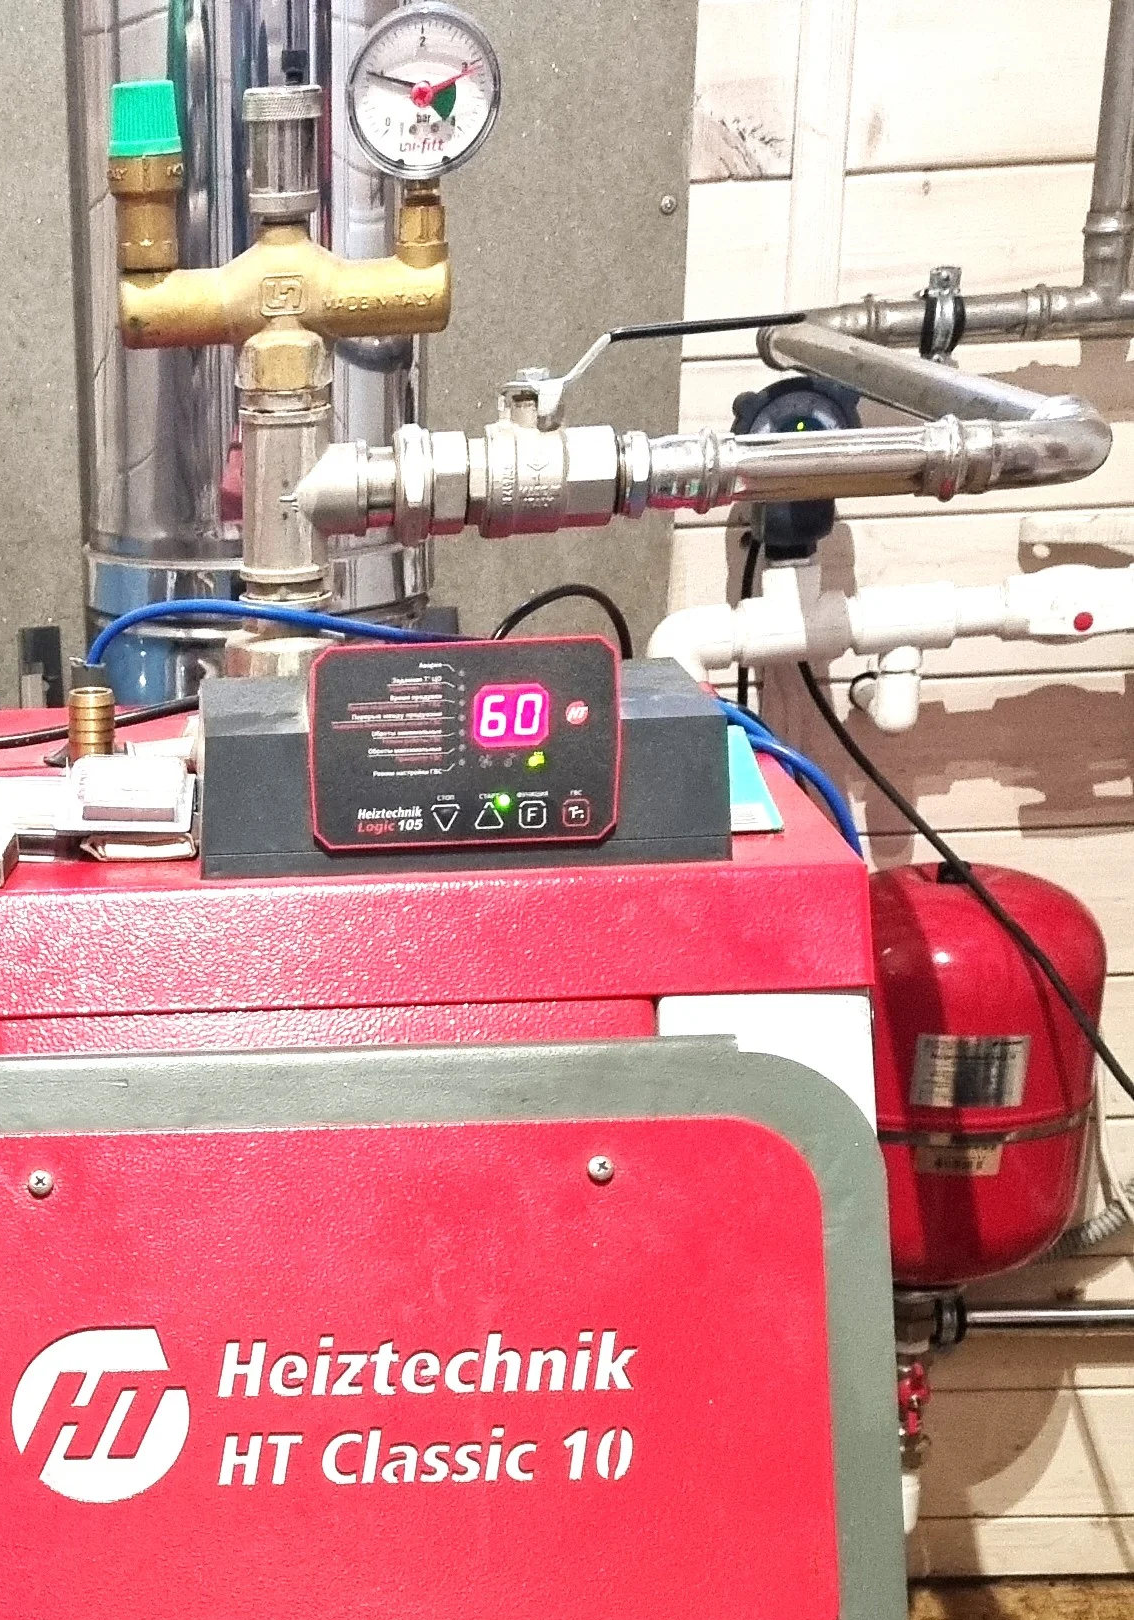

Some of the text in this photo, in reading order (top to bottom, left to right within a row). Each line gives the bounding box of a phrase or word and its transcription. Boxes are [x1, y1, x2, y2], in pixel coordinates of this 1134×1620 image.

[419, 36, 427, 48] 2
[385, 117, 392, 127] 0
[416, 112, 431, 124] bar
[480, 694, 543, 737] 60
[357, 806, 423, 820] Heiztechnik
[527, 807, 538, 823] F
[357, 818, 424, 836] Logic 105
[217, 1329, 639, 1399] Heiztechnik
[216, 1426, 635, 1488] HT Classic 10
